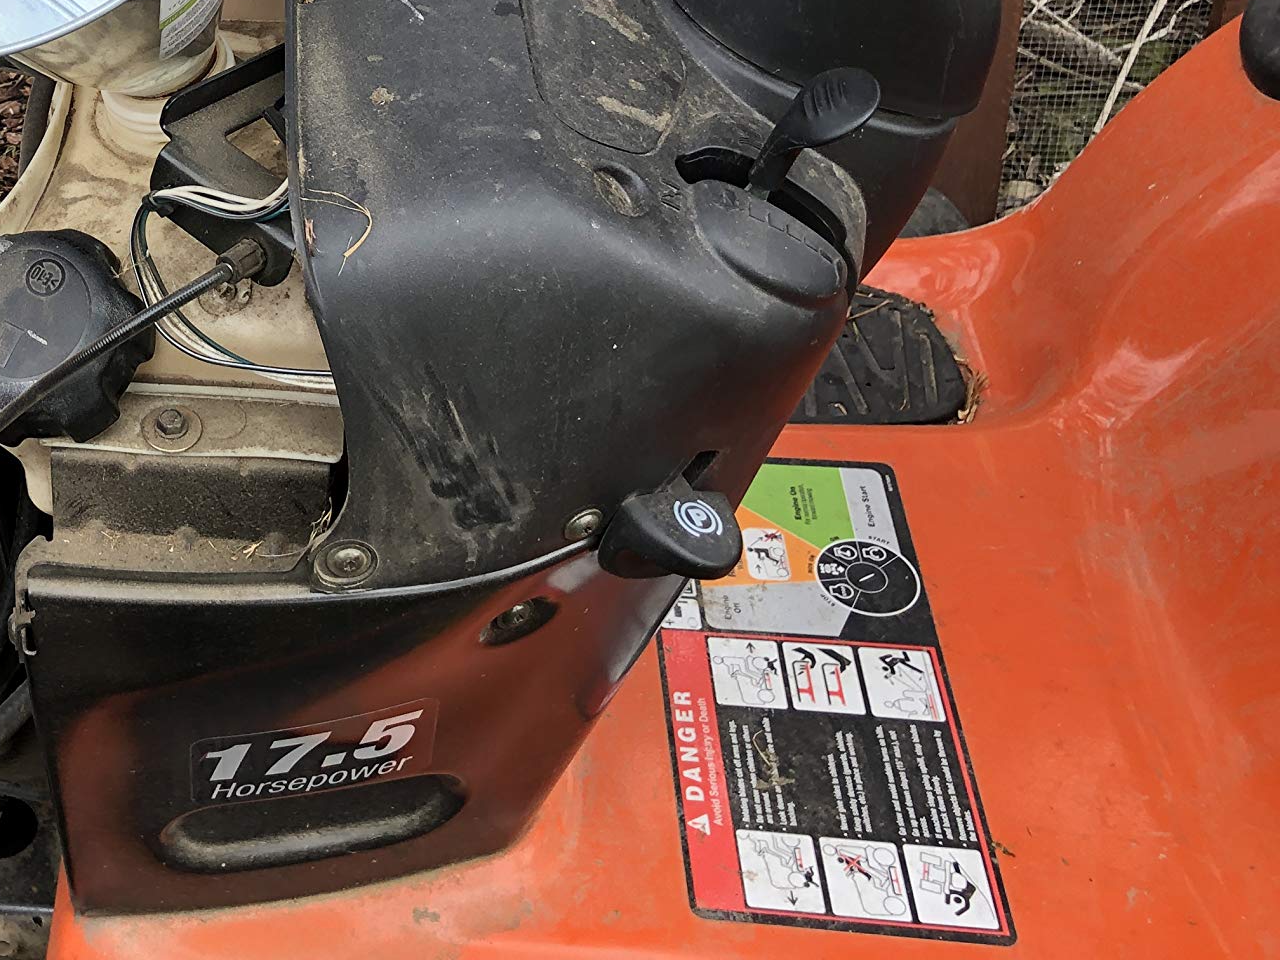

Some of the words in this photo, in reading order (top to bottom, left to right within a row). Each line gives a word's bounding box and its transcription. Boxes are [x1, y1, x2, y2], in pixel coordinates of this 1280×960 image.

[788, 486, 796, 495] On
[858, 485, 869, 502] Start
[791, 497, 802, 519] Engine
[863, 504, 876, 526] Engine
[868, 535, 890, 545] START
[722, 594, 733, 619] Engine
[696, 697, 708, 722] Death
[699, 724, 710, 733] or
[205, 709, 424, 782] 17.5
[671, 690, 705, 802] DANGER
[701, 734, 715, 760] Injury
[211, 756, 413, 800] Horsepower
[704, 761, 719, 796] Serious
[709, 798, 723, 825] Avoid
